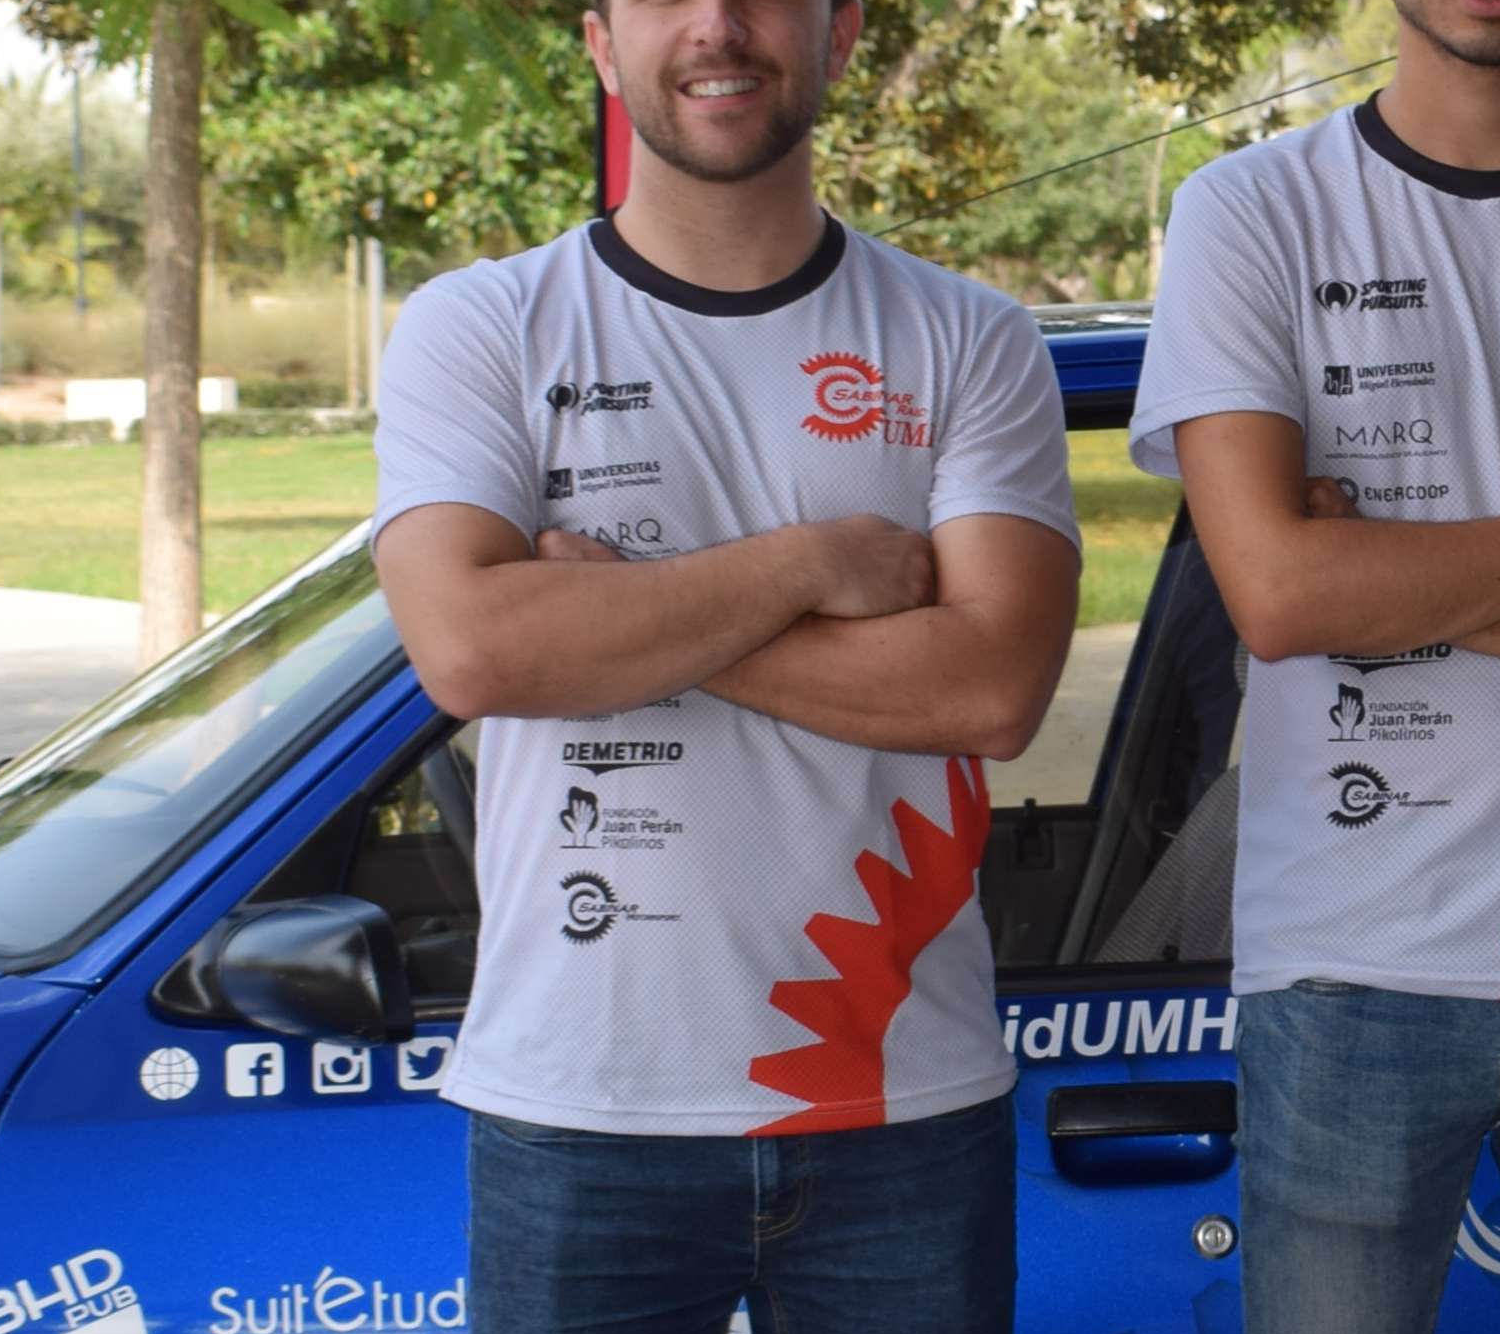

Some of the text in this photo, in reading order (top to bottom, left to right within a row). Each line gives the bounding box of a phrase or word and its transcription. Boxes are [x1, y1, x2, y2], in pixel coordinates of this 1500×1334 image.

[1361, 278, 1427, 296] SPORTING
[1357, 362, 1434, 379] UNIVERSITAS
[1336, 419, 1433, 445] MARQ
[578, 461, 660, 480] UNIVERSITAS
[579, 518, 663, 544] ARQ
[1369, 712, 1452, 726] Juan Perán
[1369, 728, 1435, 741] Pikolinos
[562, 742, 683, 761] DEMETRIO
[602, 819, 683, 833] Juan Perán
[602, 836, 665, 850] Pikolinos
[63, 1285, 139, 1329] PUB
